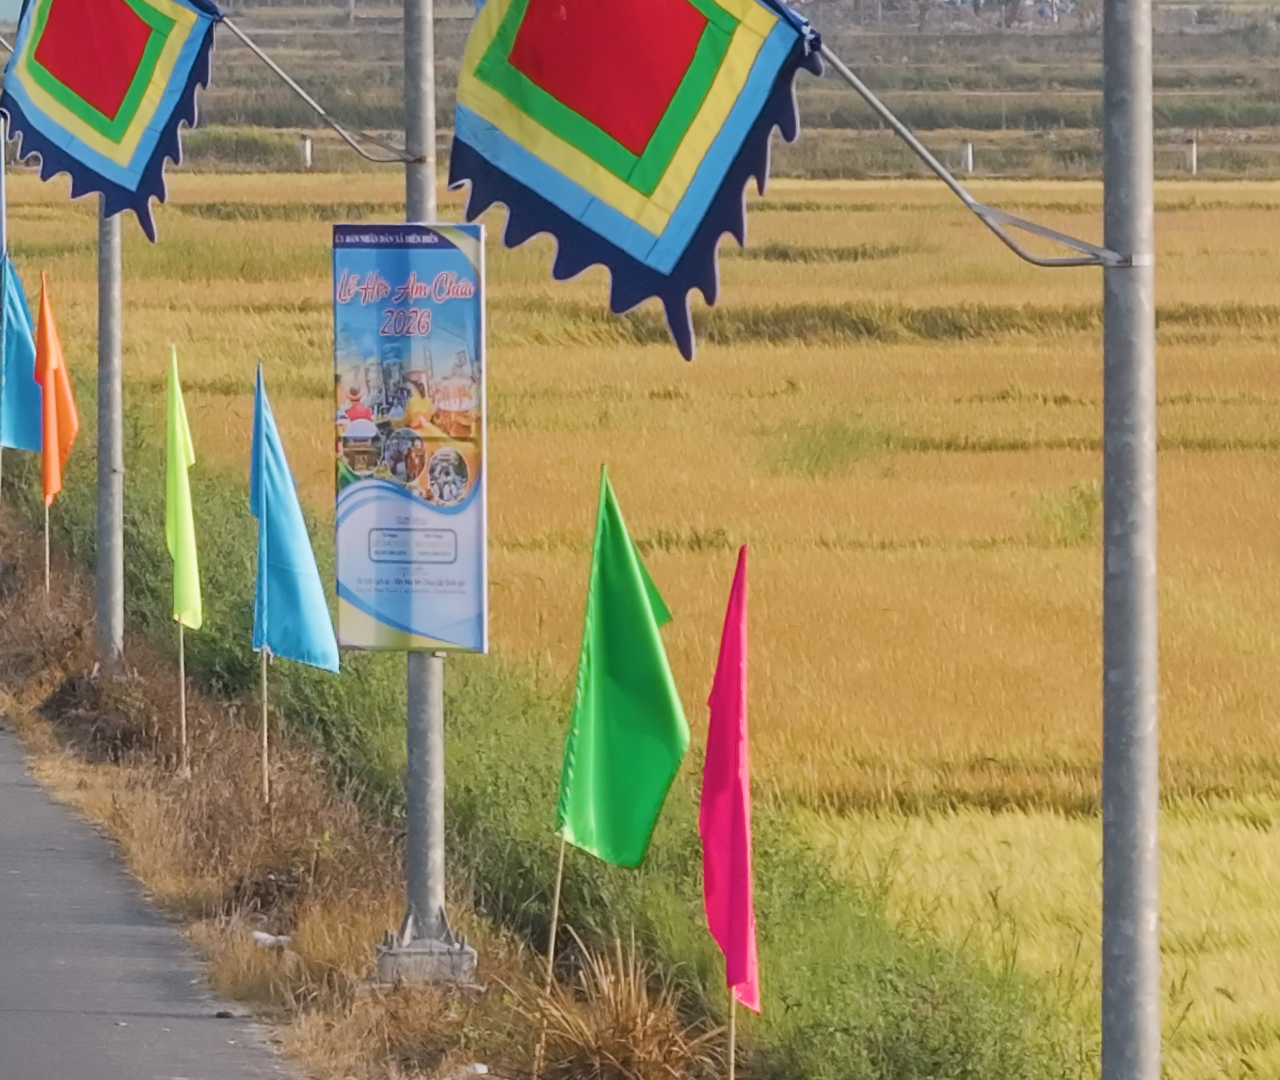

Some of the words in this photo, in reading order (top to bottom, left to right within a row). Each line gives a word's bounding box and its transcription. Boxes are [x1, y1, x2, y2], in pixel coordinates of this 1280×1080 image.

[336, 268, 359, 304] Lễ
[392, 271, 428, 304] Am
[379, 308, 432, 336] 2026
